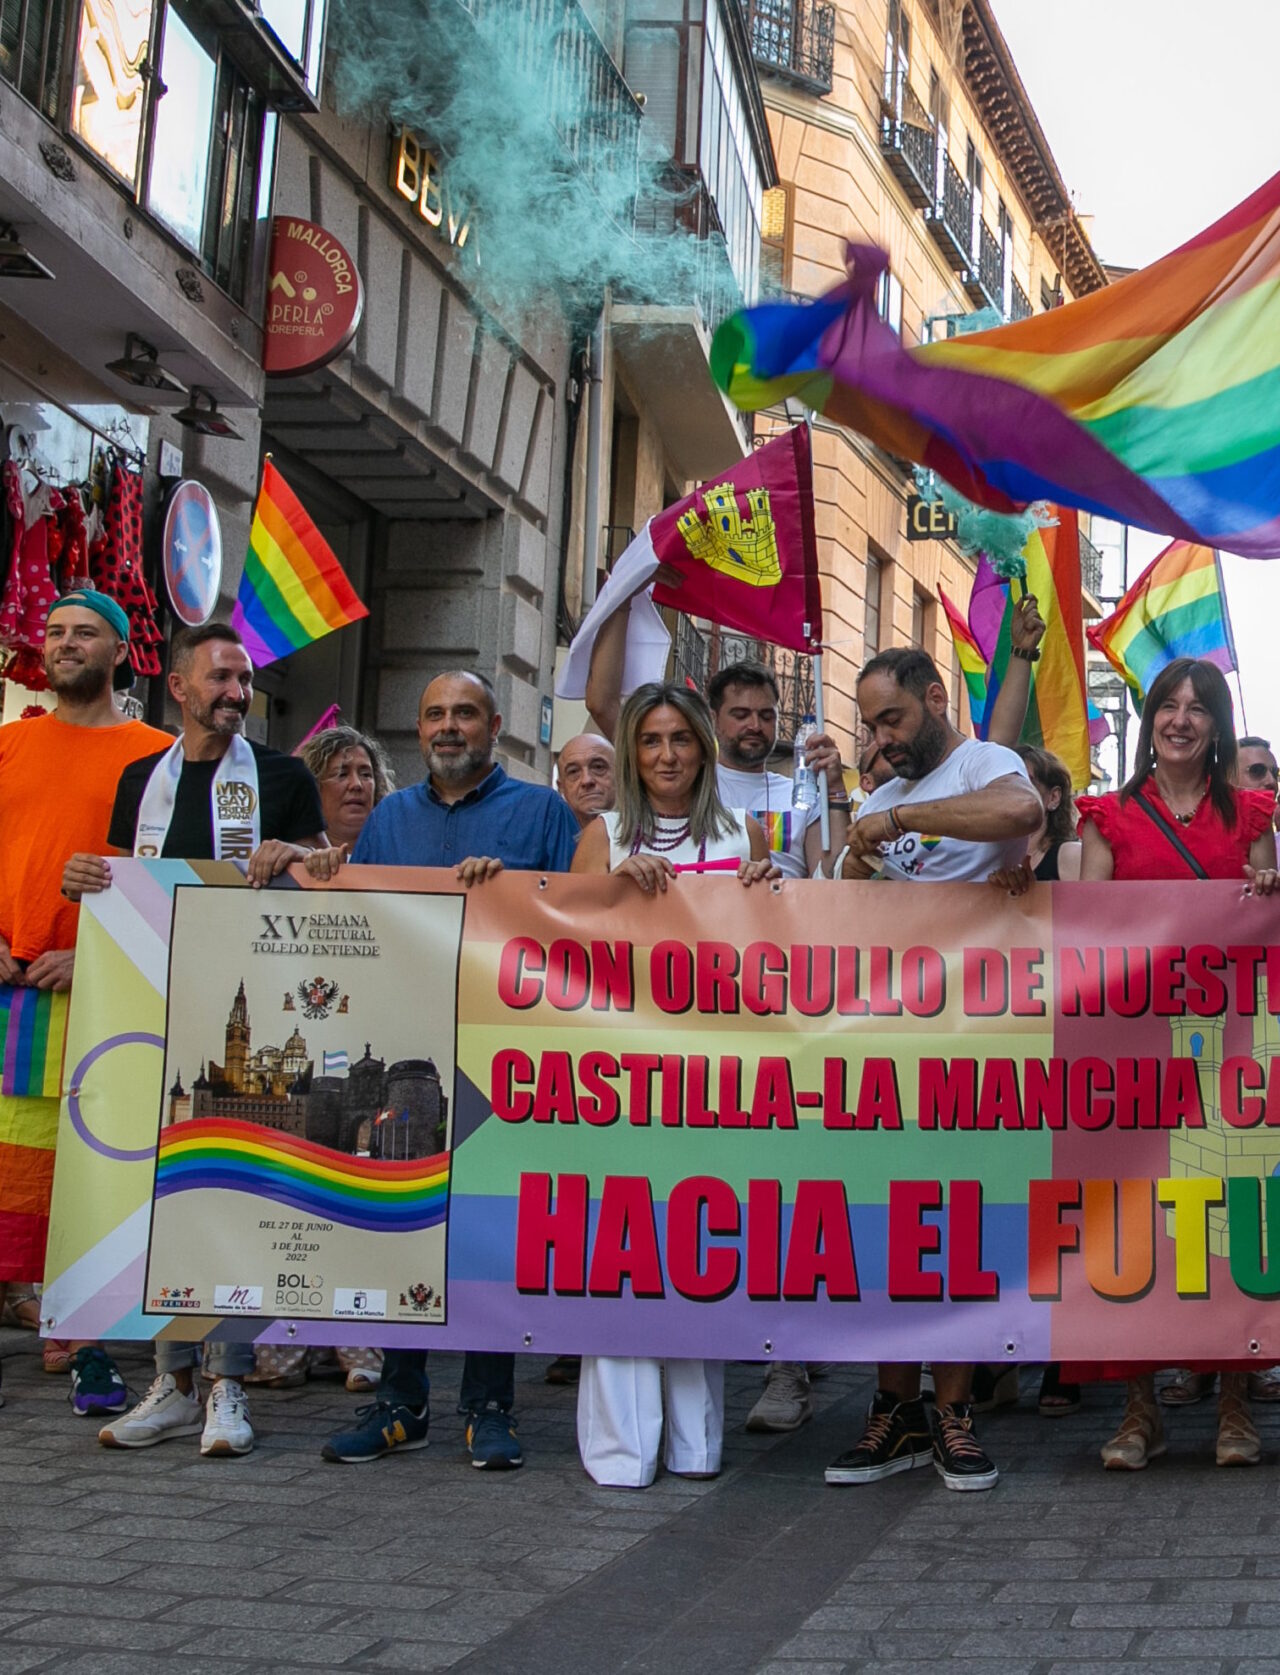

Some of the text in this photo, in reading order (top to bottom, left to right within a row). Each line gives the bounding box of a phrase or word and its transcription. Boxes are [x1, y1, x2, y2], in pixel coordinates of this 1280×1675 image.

[287, 222, 353, 296] MALLORCA
[271, 304, 324, 325] PERLA
[216, 782, 248, 795] MR
[217, 796, 247, 806] GAY
[309, 914, 369, 927] SEMANA
[308, 929, 375, 941] CULTURAL
[251, 941, 381, 957] TOLEDO ENTIENDE
[498, 936, 634, 1012] CON
[649, 940, 946, 1017] ORGULLO
[962, 946, 1047, 1018] DE
[490, 1048, 904, 1130] CASTILLA-LA
[918, 1057, 1209, 1131] MANCHA
[259, 1221, 334, 1232] DEL 27 DE JUNIO
[291, 1233, 303, 1241] AL
[516, 1172, 862, 1303] HACIA
[888, 1178, 1000, 1303] EL
[271, 1241, 320, 1252] 3 DE JULIO
[285, 1252, 308, 1262] 2022
[277, 1274, 324, 1289] BOLO
[151, 1300, 201, 1308] JUVENTUD
[275, 1291, 323, 1306] BOLO
